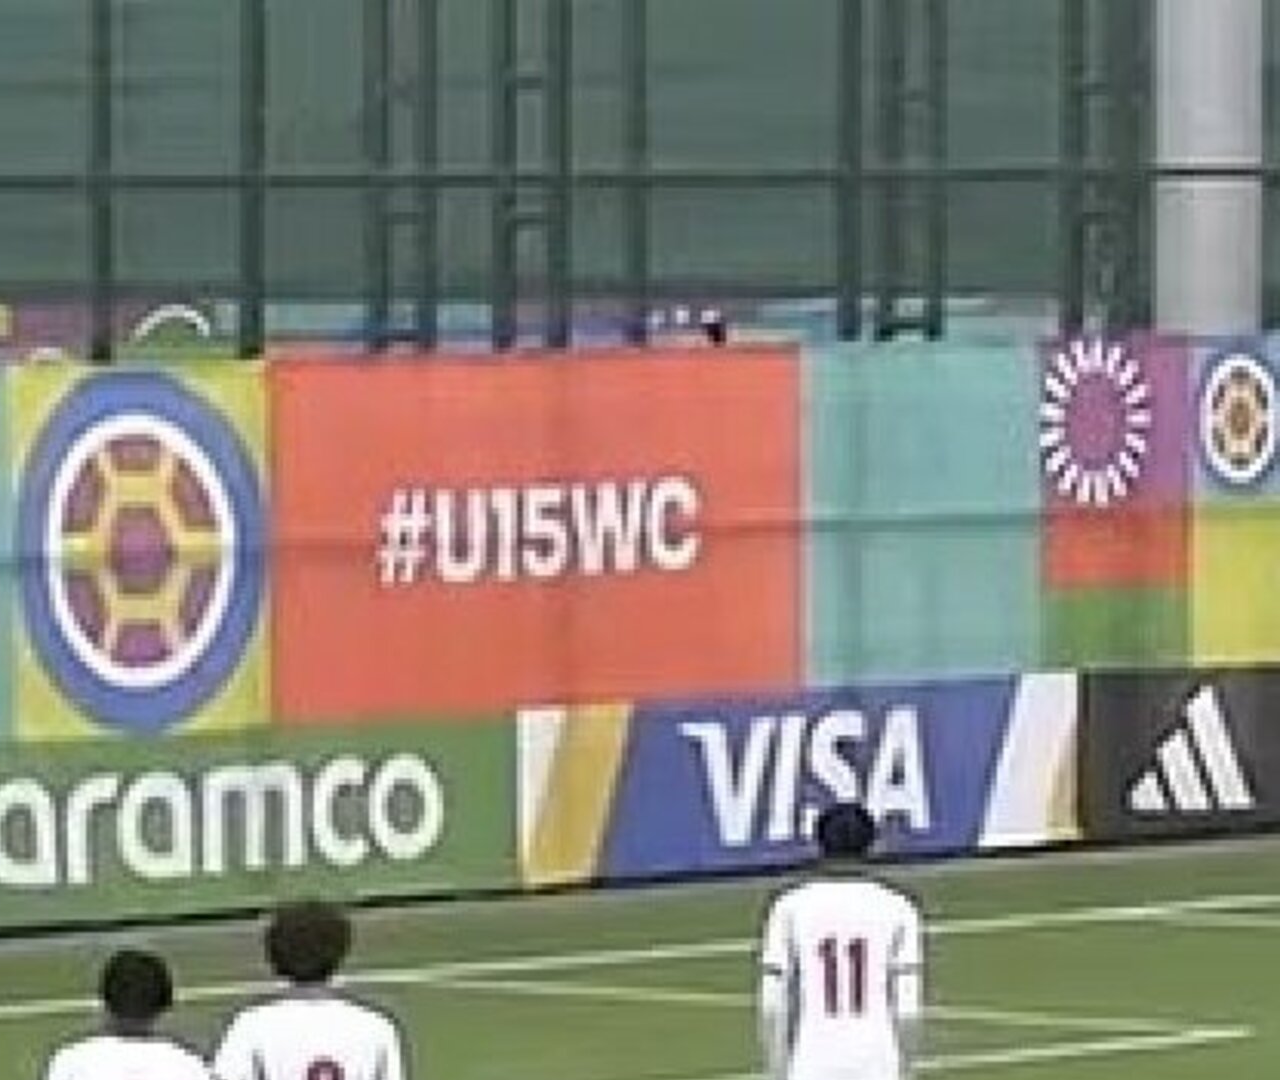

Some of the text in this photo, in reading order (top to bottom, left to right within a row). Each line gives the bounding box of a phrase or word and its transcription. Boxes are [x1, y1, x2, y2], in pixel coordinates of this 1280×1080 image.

[379, 477, 701, 584] #U15WC
[677, 704, 931, 847] VISA
[818, 936, 871, 1016] 11
